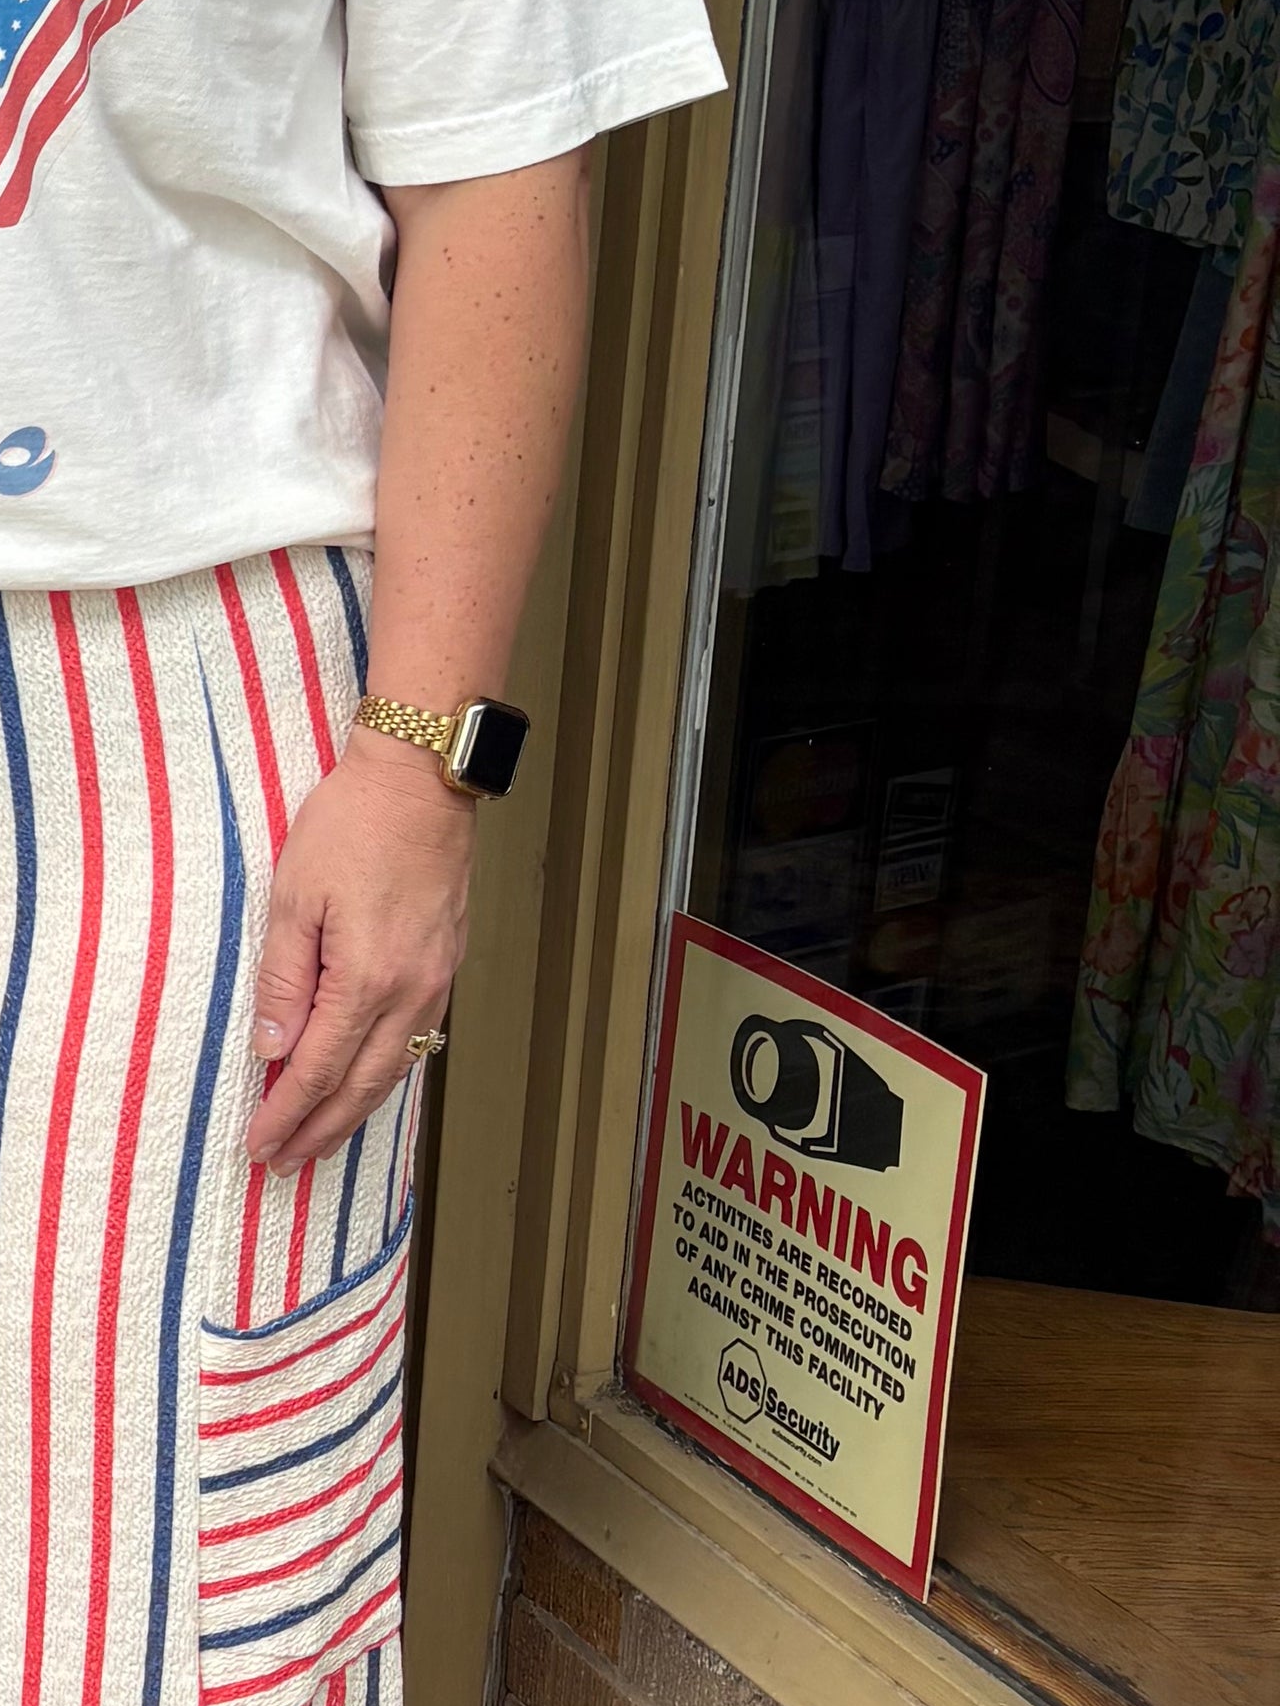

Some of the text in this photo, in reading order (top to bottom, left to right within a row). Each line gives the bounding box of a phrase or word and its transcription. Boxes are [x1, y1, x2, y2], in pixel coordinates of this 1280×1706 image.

[672, 1201, 917, 1380] TO AID IN THE PROSECUTION
[681, 1101, 929, 1316] WARNING
[681, 1179, 913, 1342] ACTIVITIES ARE RECORDED
[675, 1235, 905, 1403] OF ANY CRIME COMMITTED
[686, 1275, 886, 1421] AGAINST THIS FACILITY
[721, 1360, 762, 1407] ADS
[765, 1386, 841, 1461] Security
